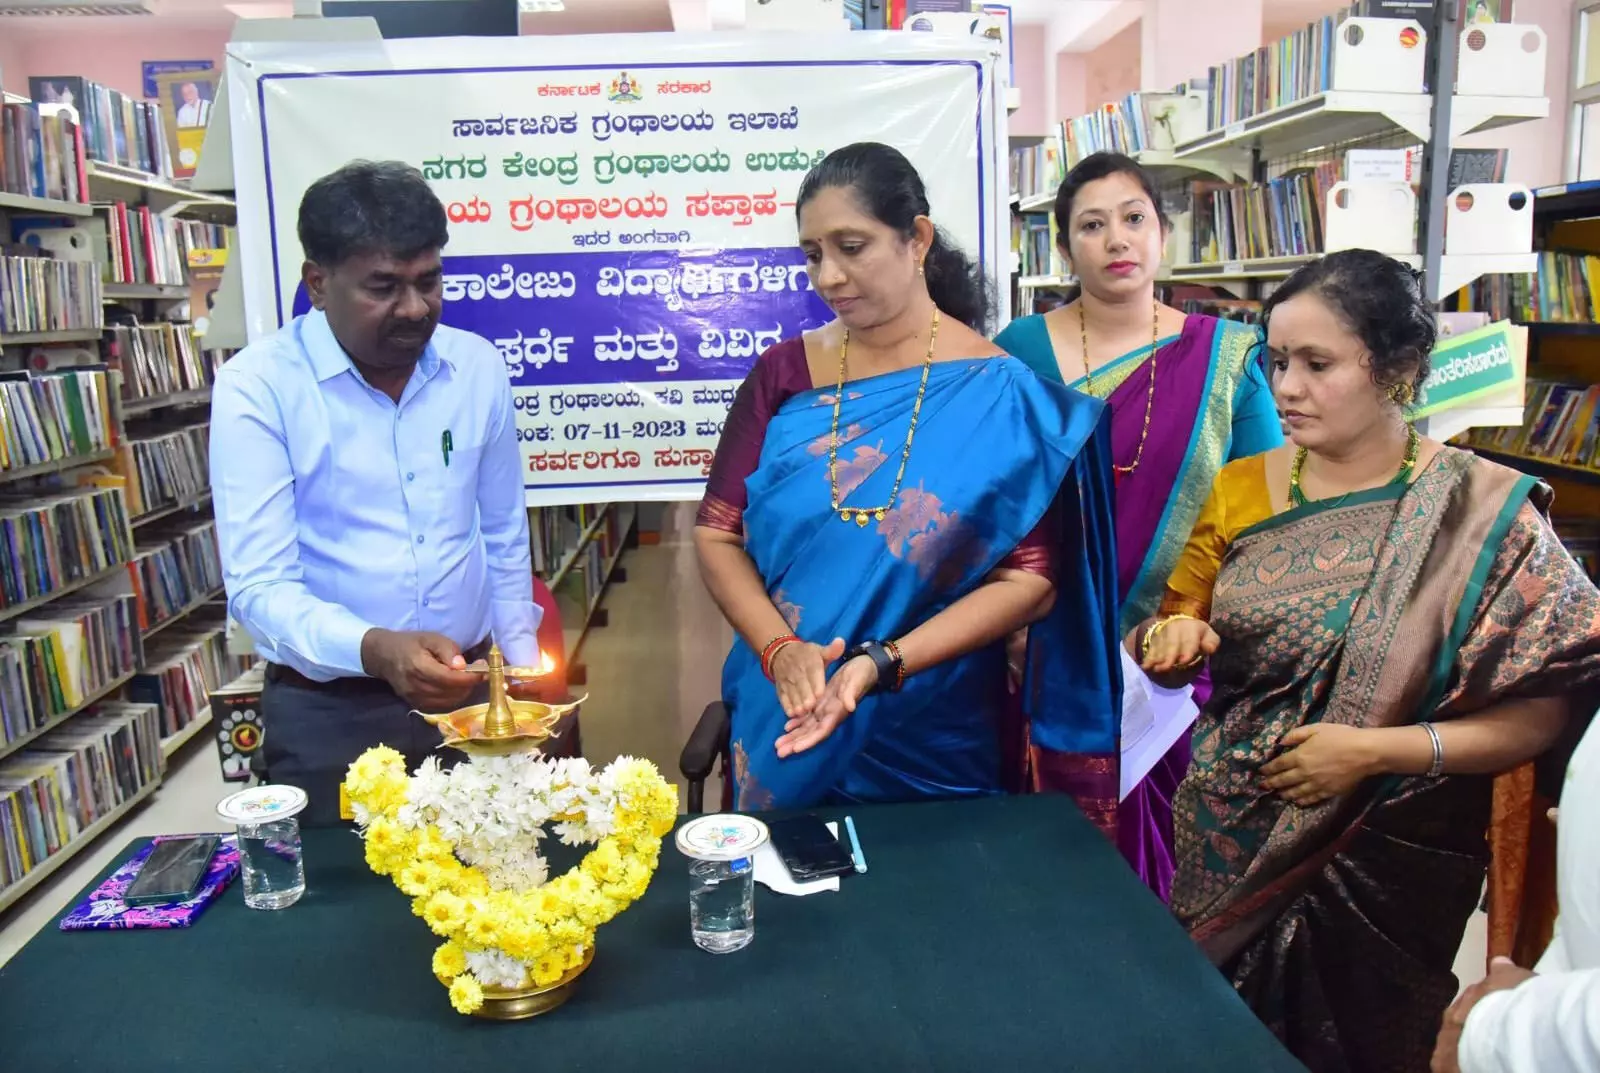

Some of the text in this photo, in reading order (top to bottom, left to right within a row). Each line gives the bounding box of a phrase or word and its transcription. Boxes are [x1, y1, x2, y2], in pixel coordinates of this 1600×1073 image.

[537, 80, 712, 98] ಕರ್ನಾಟಕ ಸರಕಾರ
[453, 106, 799, 141] ಸಾರ್ವಜನಿಕ ಗ್ರಂಥಾಲಯ ಇಲಾಖೆ
[423, 155, 487, 181] ನಗರ
[503, 151, 579, 185] ಕೇಂದ್ರ
[594, 147, 731, 184] ಗ್ರಂಥಾಲಯ
[509, 191, 668, 231] ಗ್ರಂಥಾಲಯ
[572, 229, 691, 247] ಇದರ ಅಂಗವಾಗಿ
[441, 257, 815, 311] ಕಾಲೇಜು ವಿದ್ಯಾರ್ಥಿಗಳಿಗ
[594, 326, 680, 372] ಮತ್ತು
[513, 392, 540, 416] ಂದ್ರ
[549, 389, 645, 415] ಗ್ರಂಥಾಲಯ,
[564, 420, 686, 440] 07-11-2023
[529, 444, 715, 476] ಸರ್ವರಿಗೂ ಸುಸ್ವಾ
